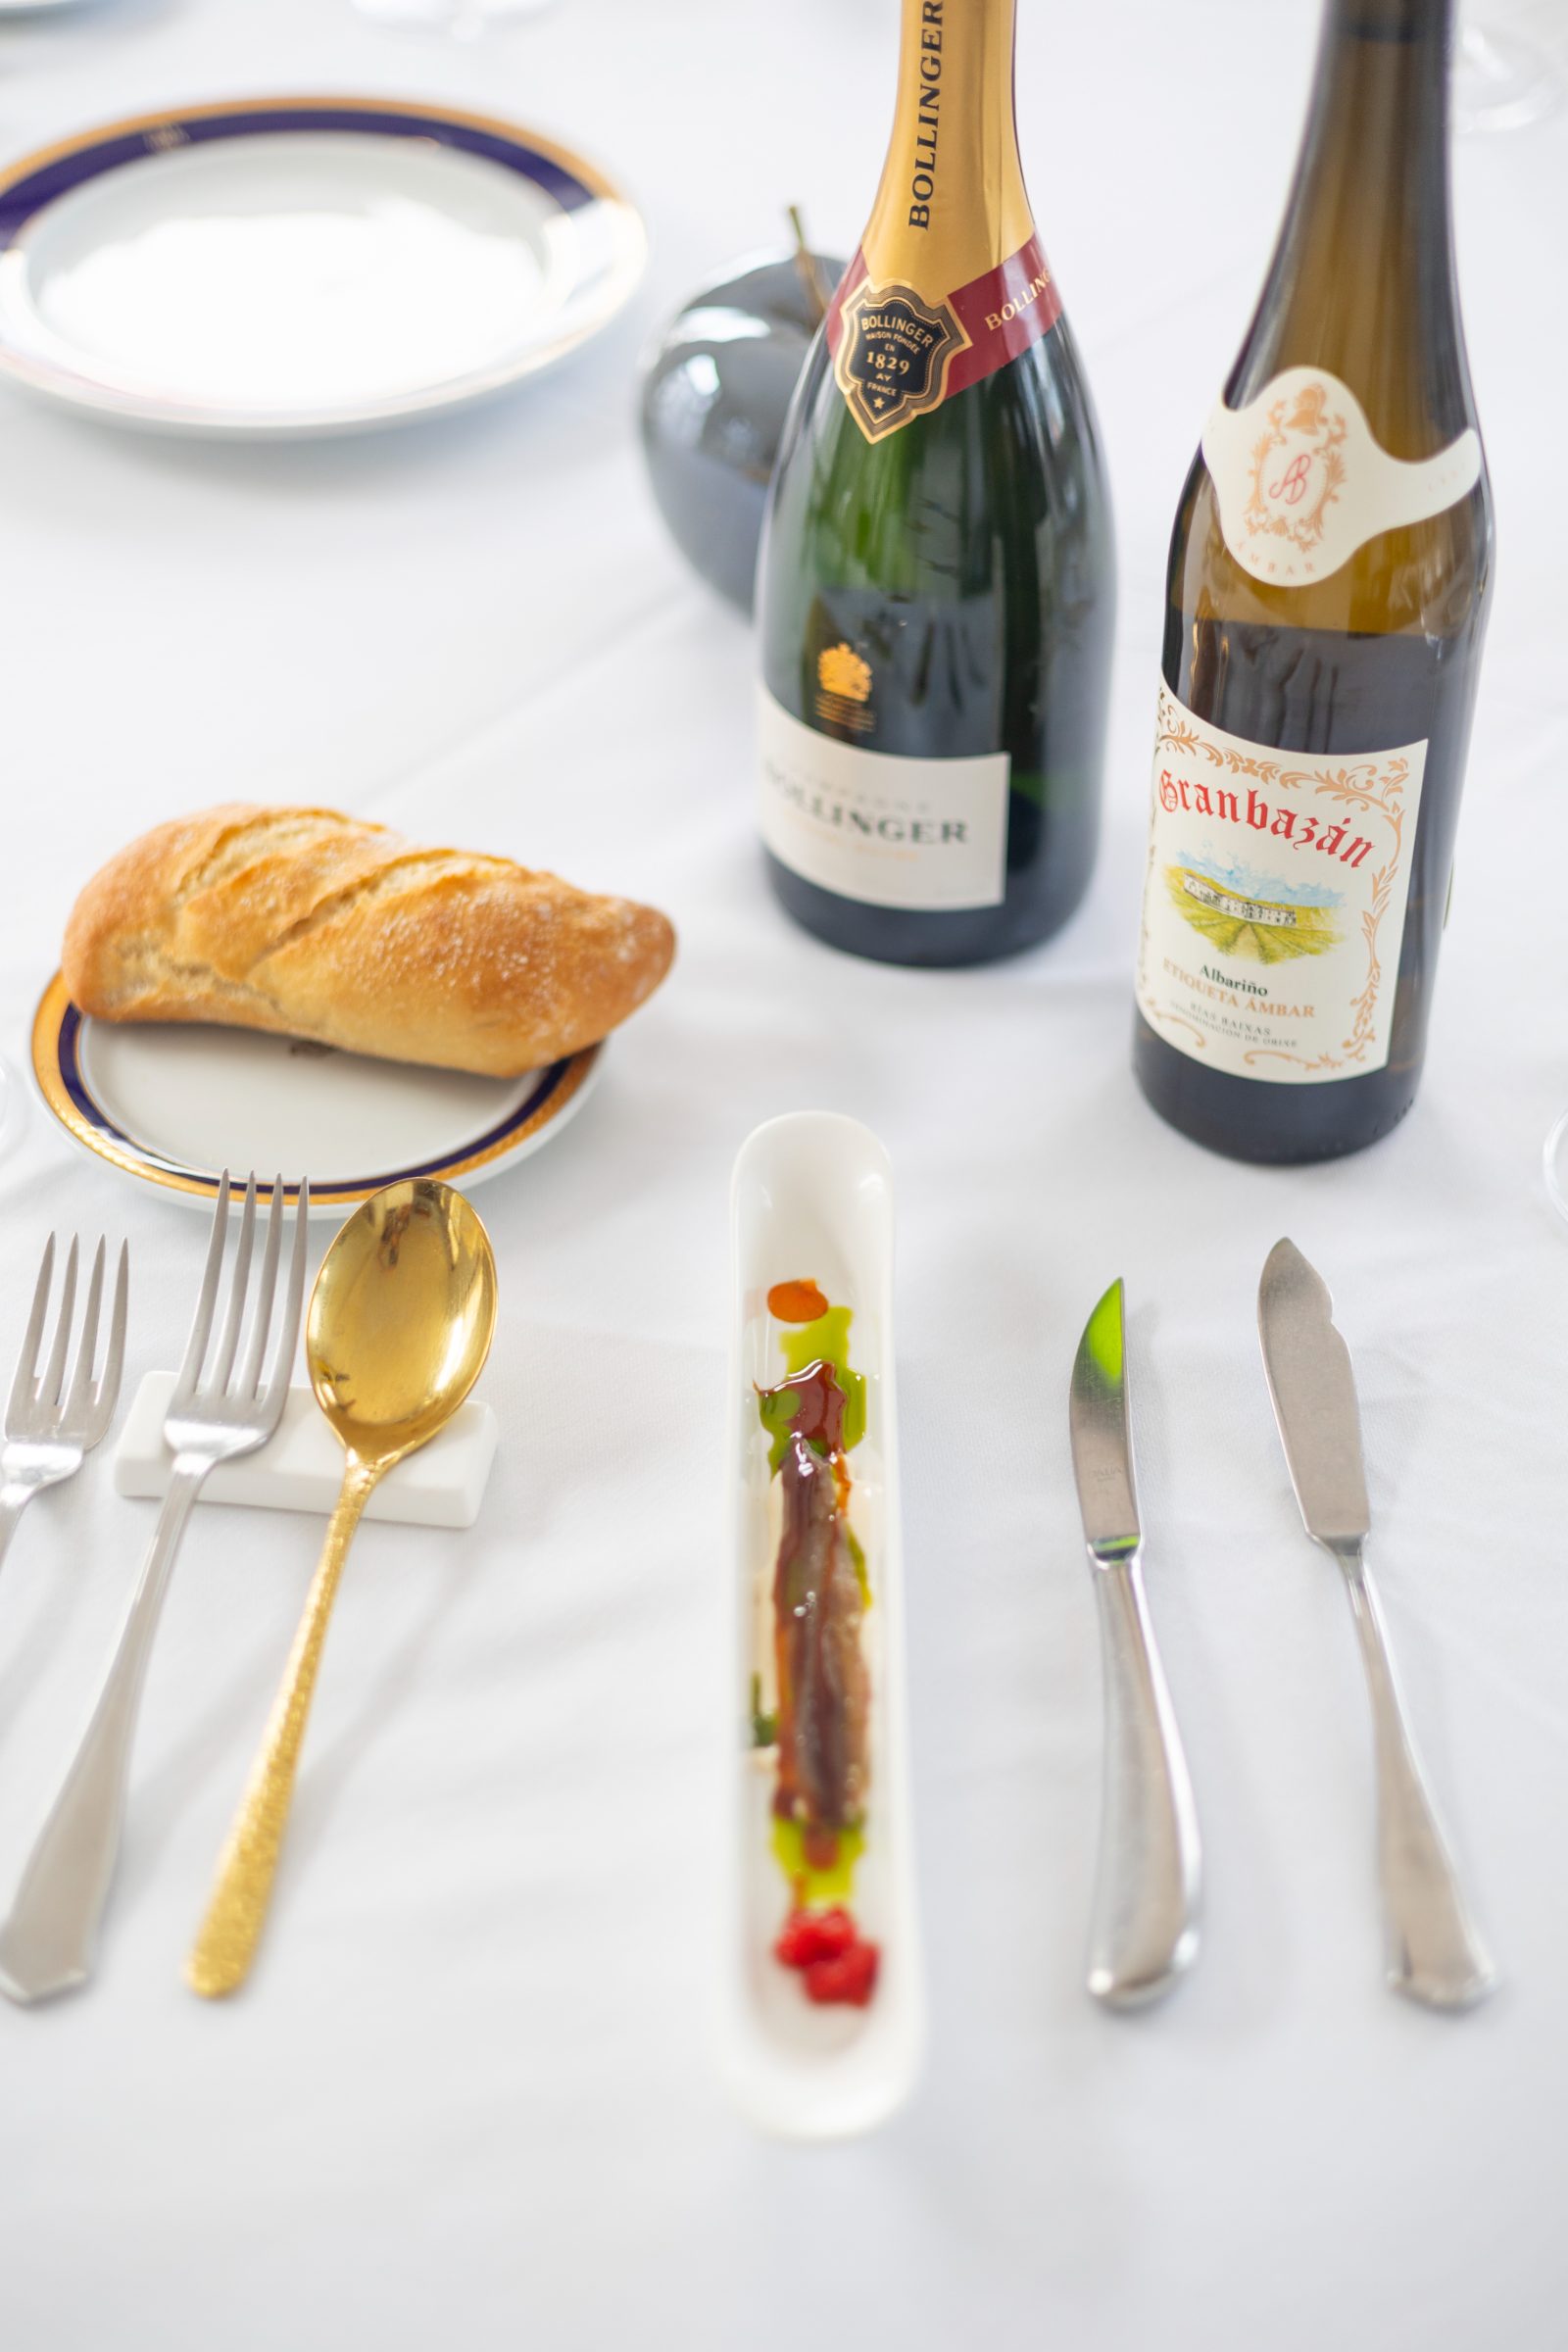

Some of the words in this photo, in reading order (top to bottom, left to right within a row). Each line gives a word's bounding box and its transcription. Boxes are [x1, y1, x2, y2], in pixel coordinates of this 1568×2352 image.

[908, 0, 943, 231] BOLLINGER
[861, 316, 934, 348] BOLLINGER
[885, 343, 896, 352] EN
[867, 351, 909, 375] 1829
[867, 381, 897, 397] FRANCE
[1159, 768, 1376, 868] Granbazán
[1162, 957, 1239, 1007] ETIQUETA
[1245, 996, 1316, 1018] ÁMBAR
[1200, 964, 1268, 997] Albariño
